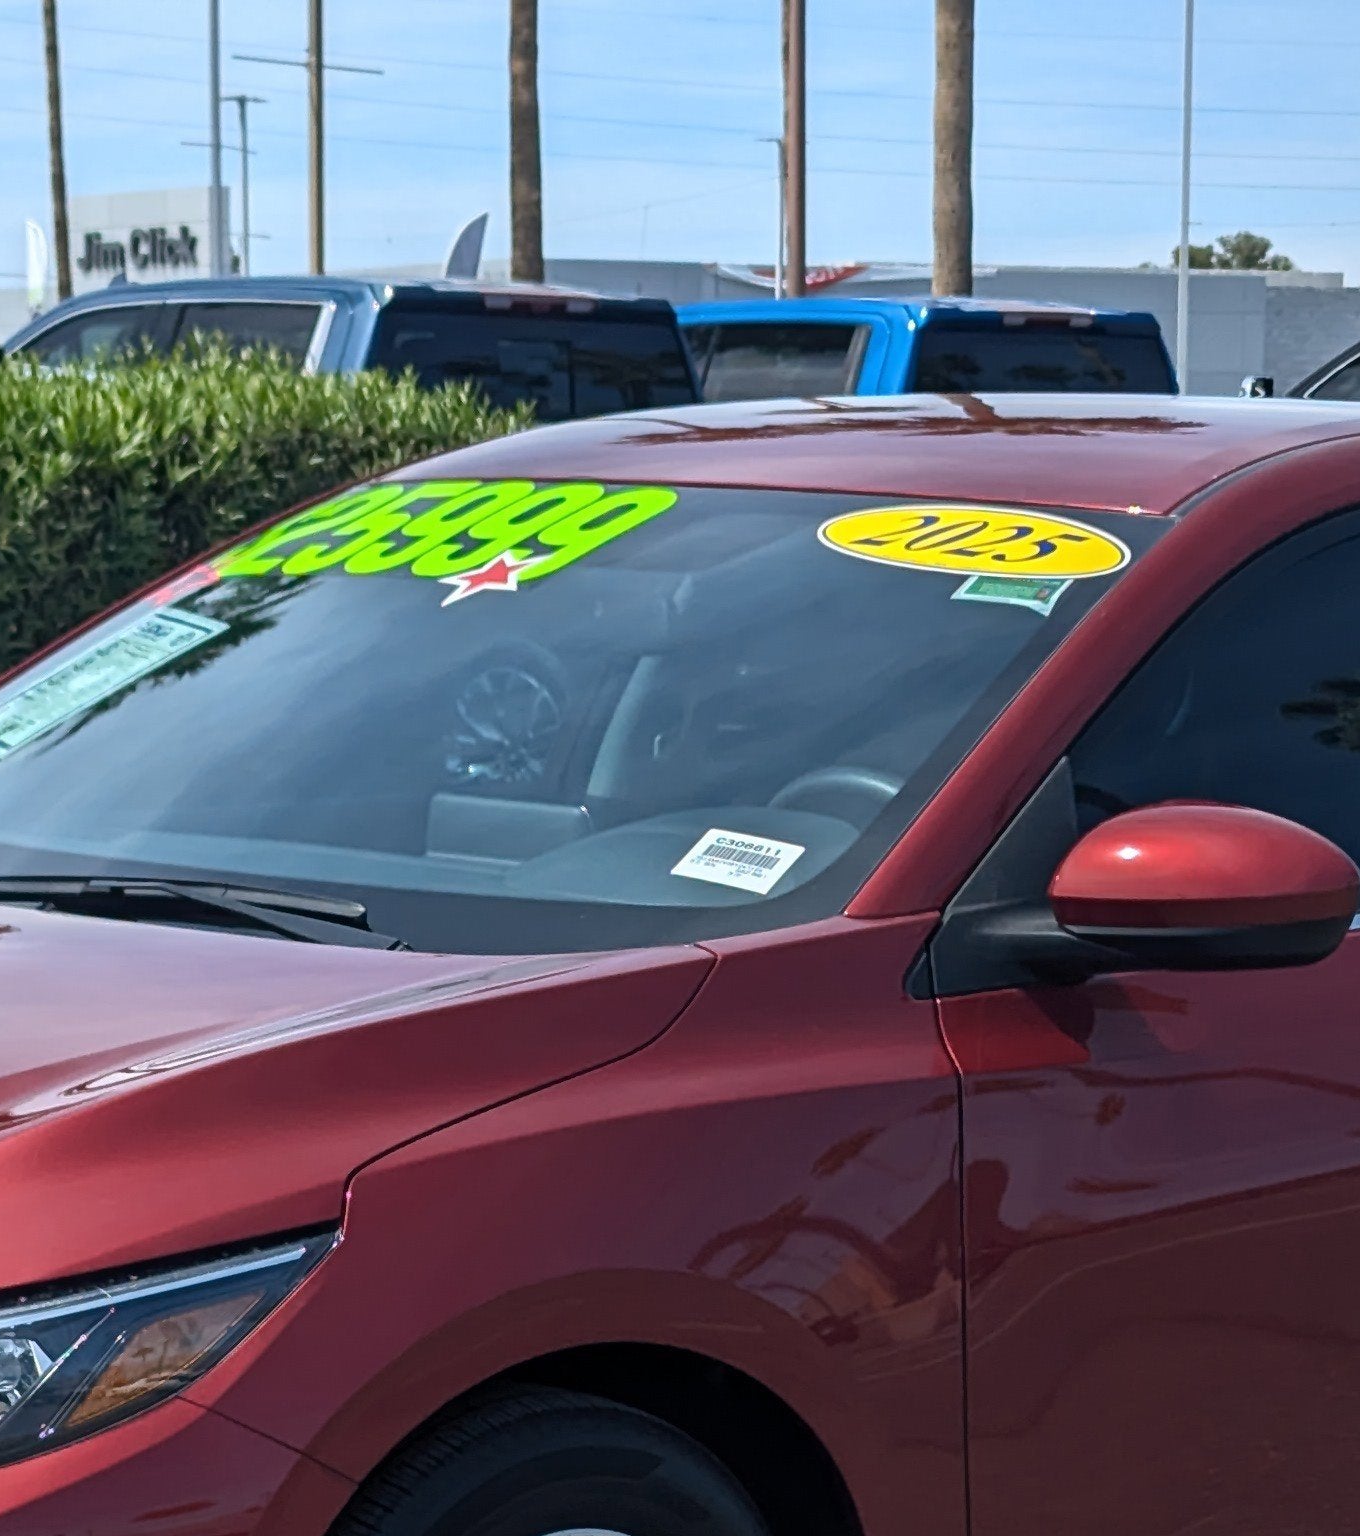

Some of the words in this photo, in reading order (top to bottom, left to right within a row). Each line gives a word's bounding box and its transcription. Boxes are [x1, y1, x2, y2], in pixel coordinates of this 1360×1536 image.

[77, 231, 126, 272] Jim
[130, 225, 198, 269] Click
[848, 515, 1091, 563] 2025
